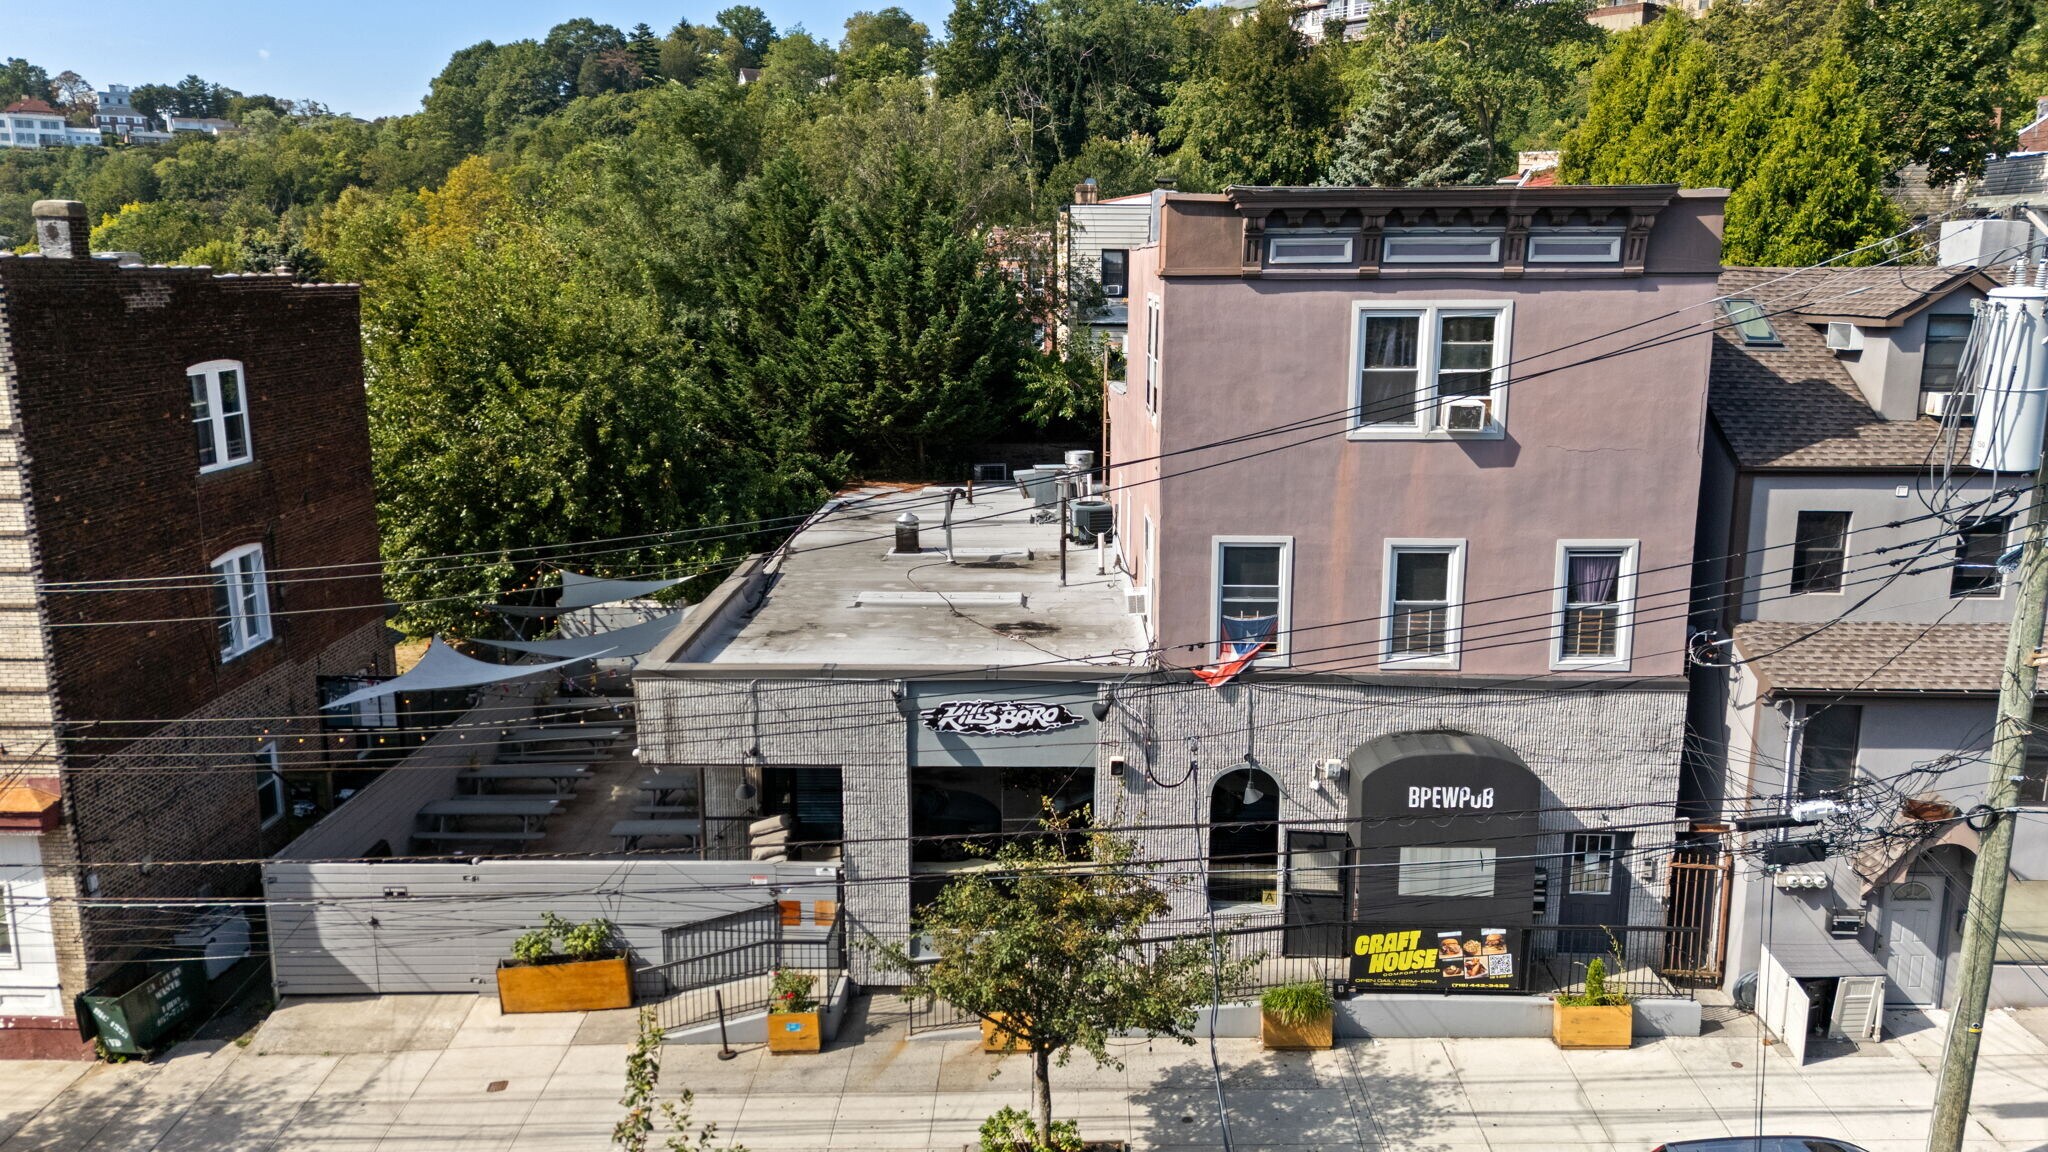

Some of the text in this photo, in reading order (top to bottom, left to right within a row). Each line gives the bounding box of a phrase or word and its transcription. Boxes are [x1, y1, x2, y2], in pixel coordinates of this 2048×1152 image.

[1264, 893, 1275, 903] A
[1354, 930, 1422, 956] CRAFT
[1368, 948, 1439, 974] HOUSE
[1382, 970, 1419, 978] COMFORT
